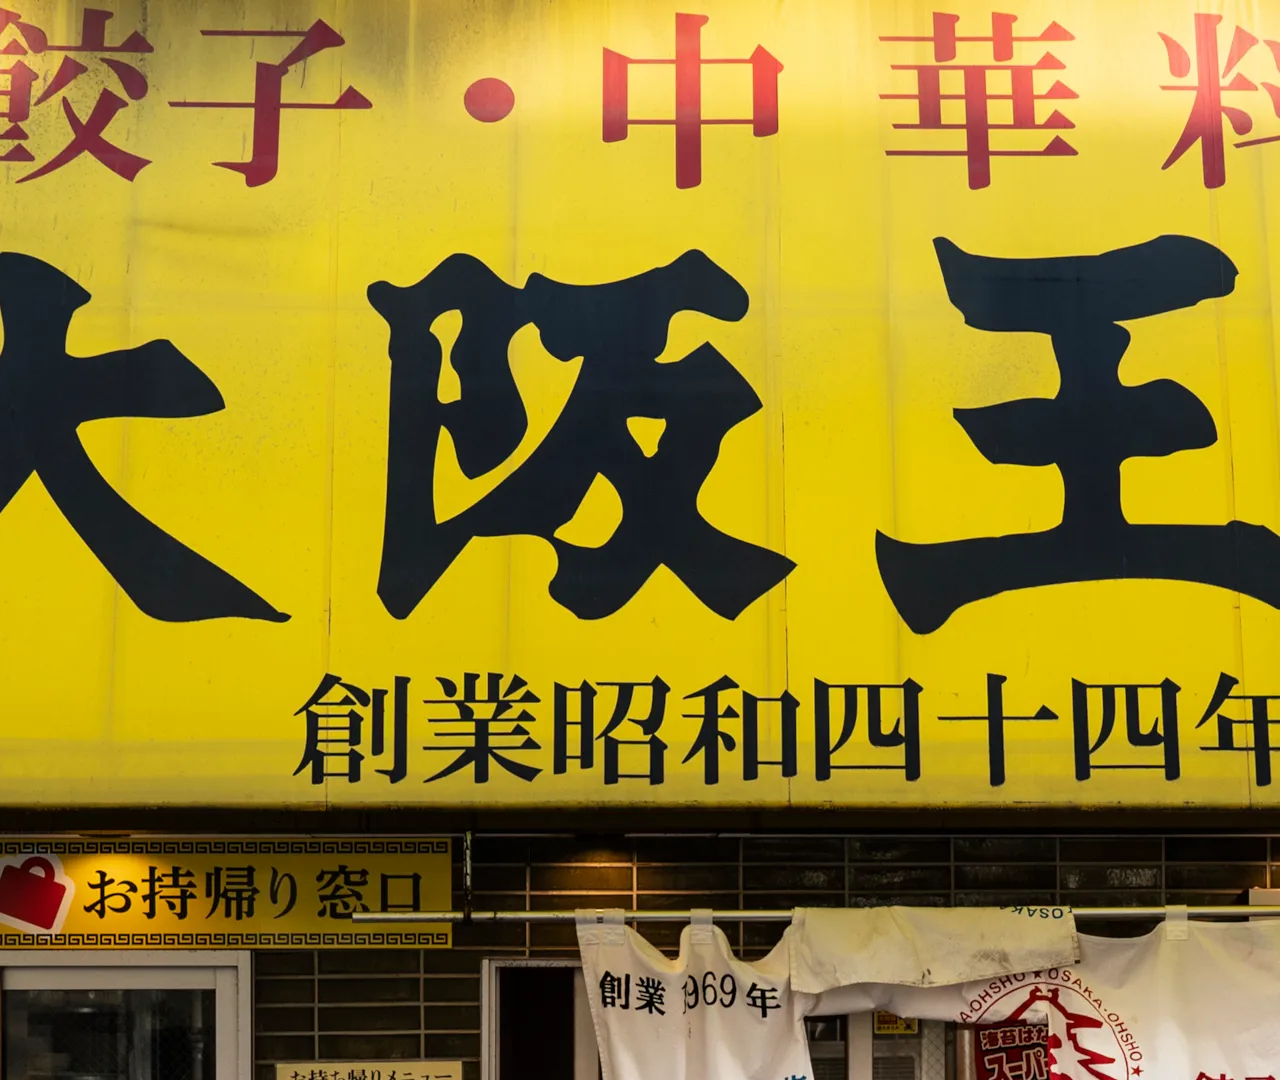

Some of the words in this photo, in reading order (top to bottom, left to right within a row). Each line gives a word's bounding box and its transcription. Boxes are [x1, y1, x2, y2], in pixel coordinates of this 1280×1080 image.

[83, 864, 423, 921] お持帰り窓口
